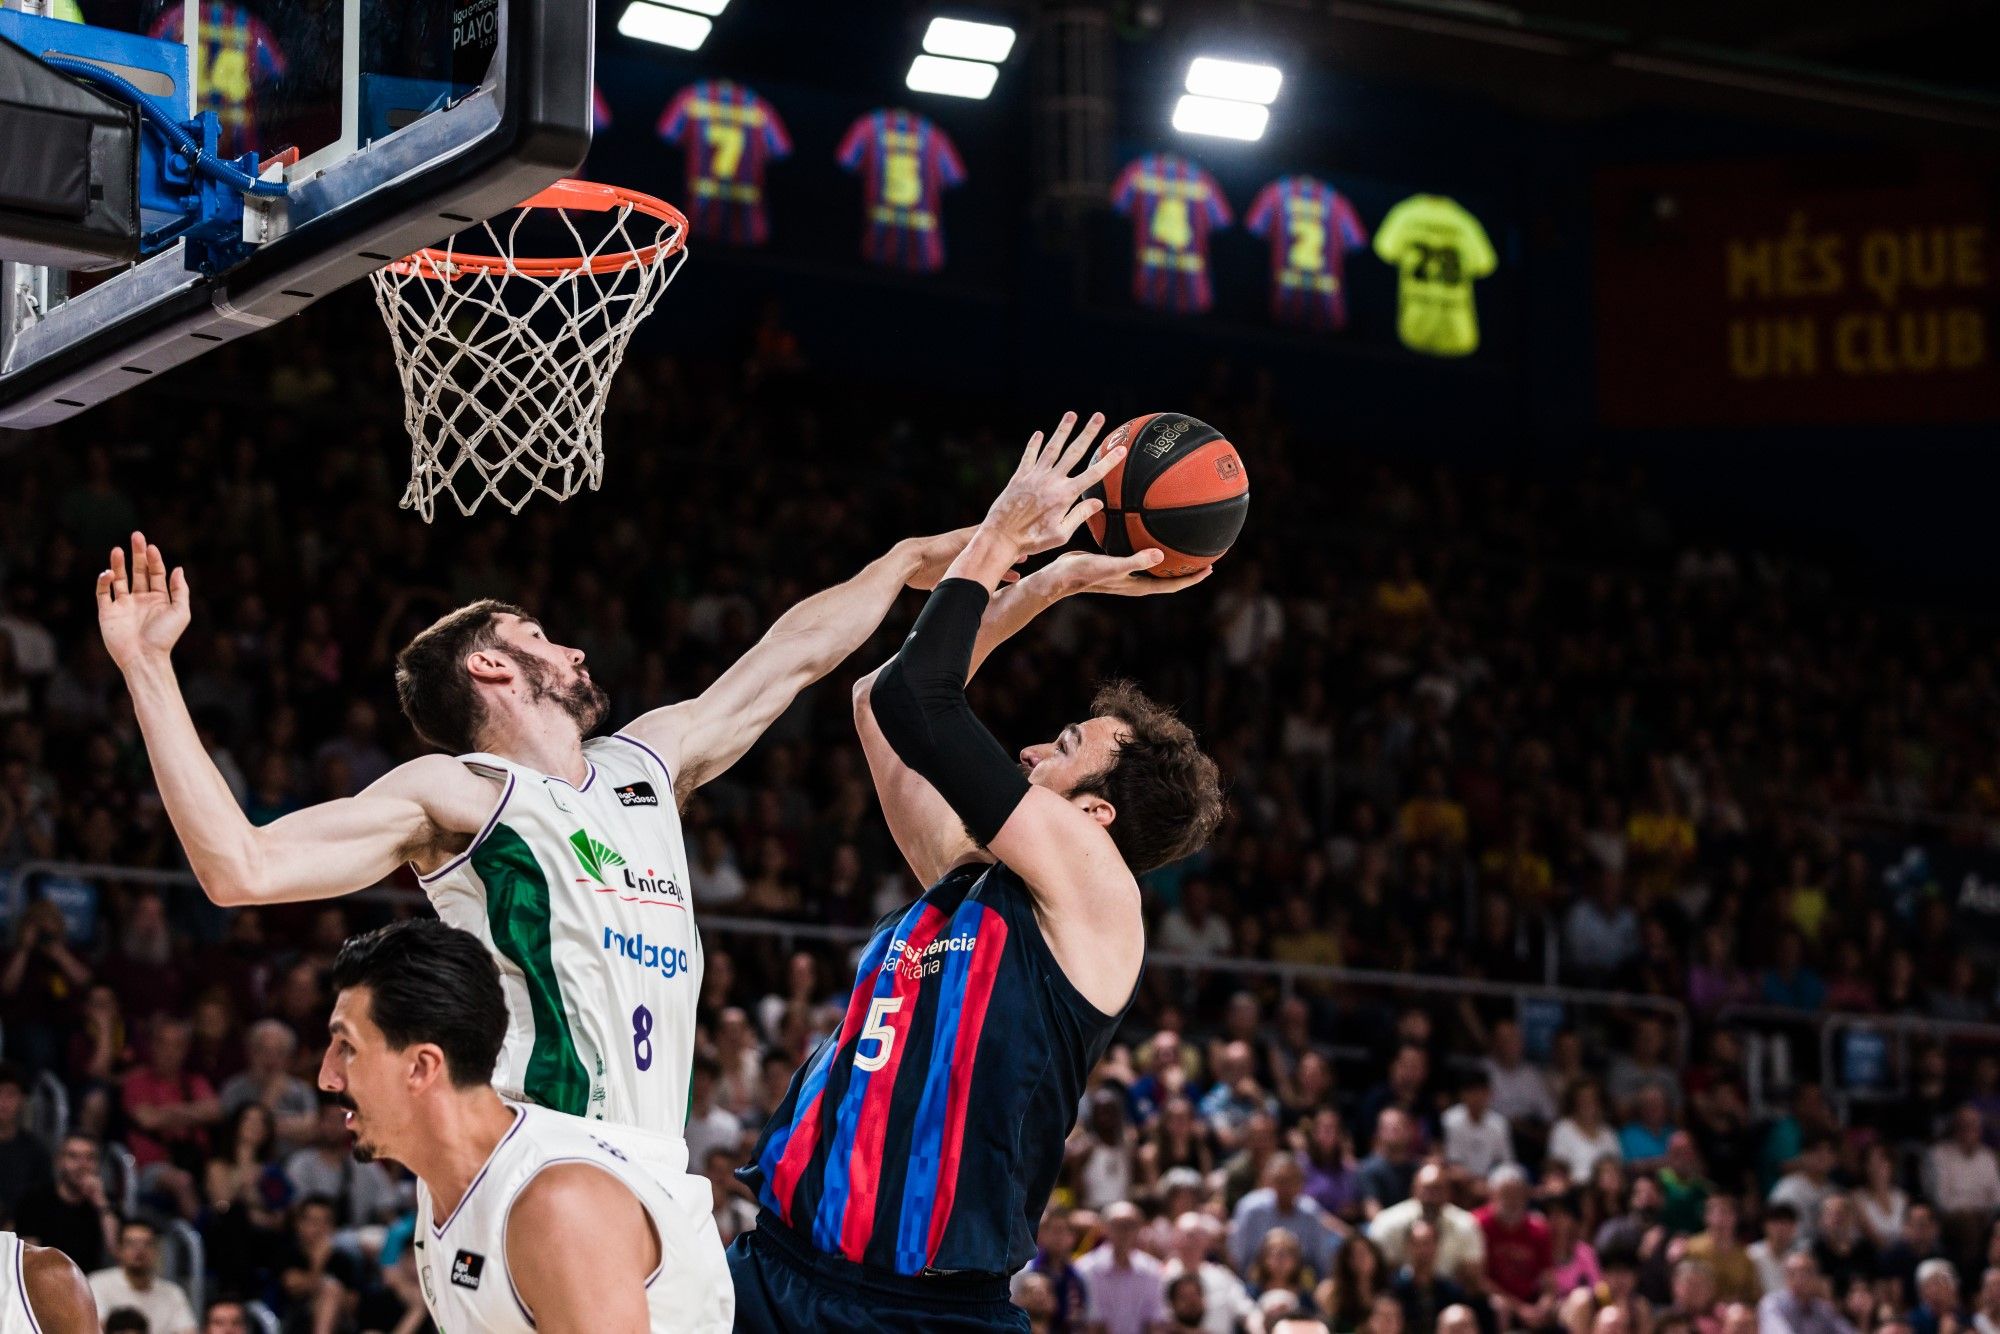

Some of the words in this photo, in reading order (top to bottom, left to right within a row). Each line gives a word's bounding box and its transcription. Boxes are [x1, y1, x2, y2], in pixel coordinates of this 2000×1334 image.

[705, 126, 745, 178] 7
[1727, 209, 1844, 297] MÉS
[1861, 225, 1988, 308] QUE
[1728, 314, 1816, 378] UN
[1835, 305, 1987, 374] CLUB
[622, 795, 657, 805] endesa
[623, 868, 684, 903] Unica
[887, 933, 977, 964] ssitència
[632, 1003, 653, 1072] 8
[852, 995, 905, 1073] 5
